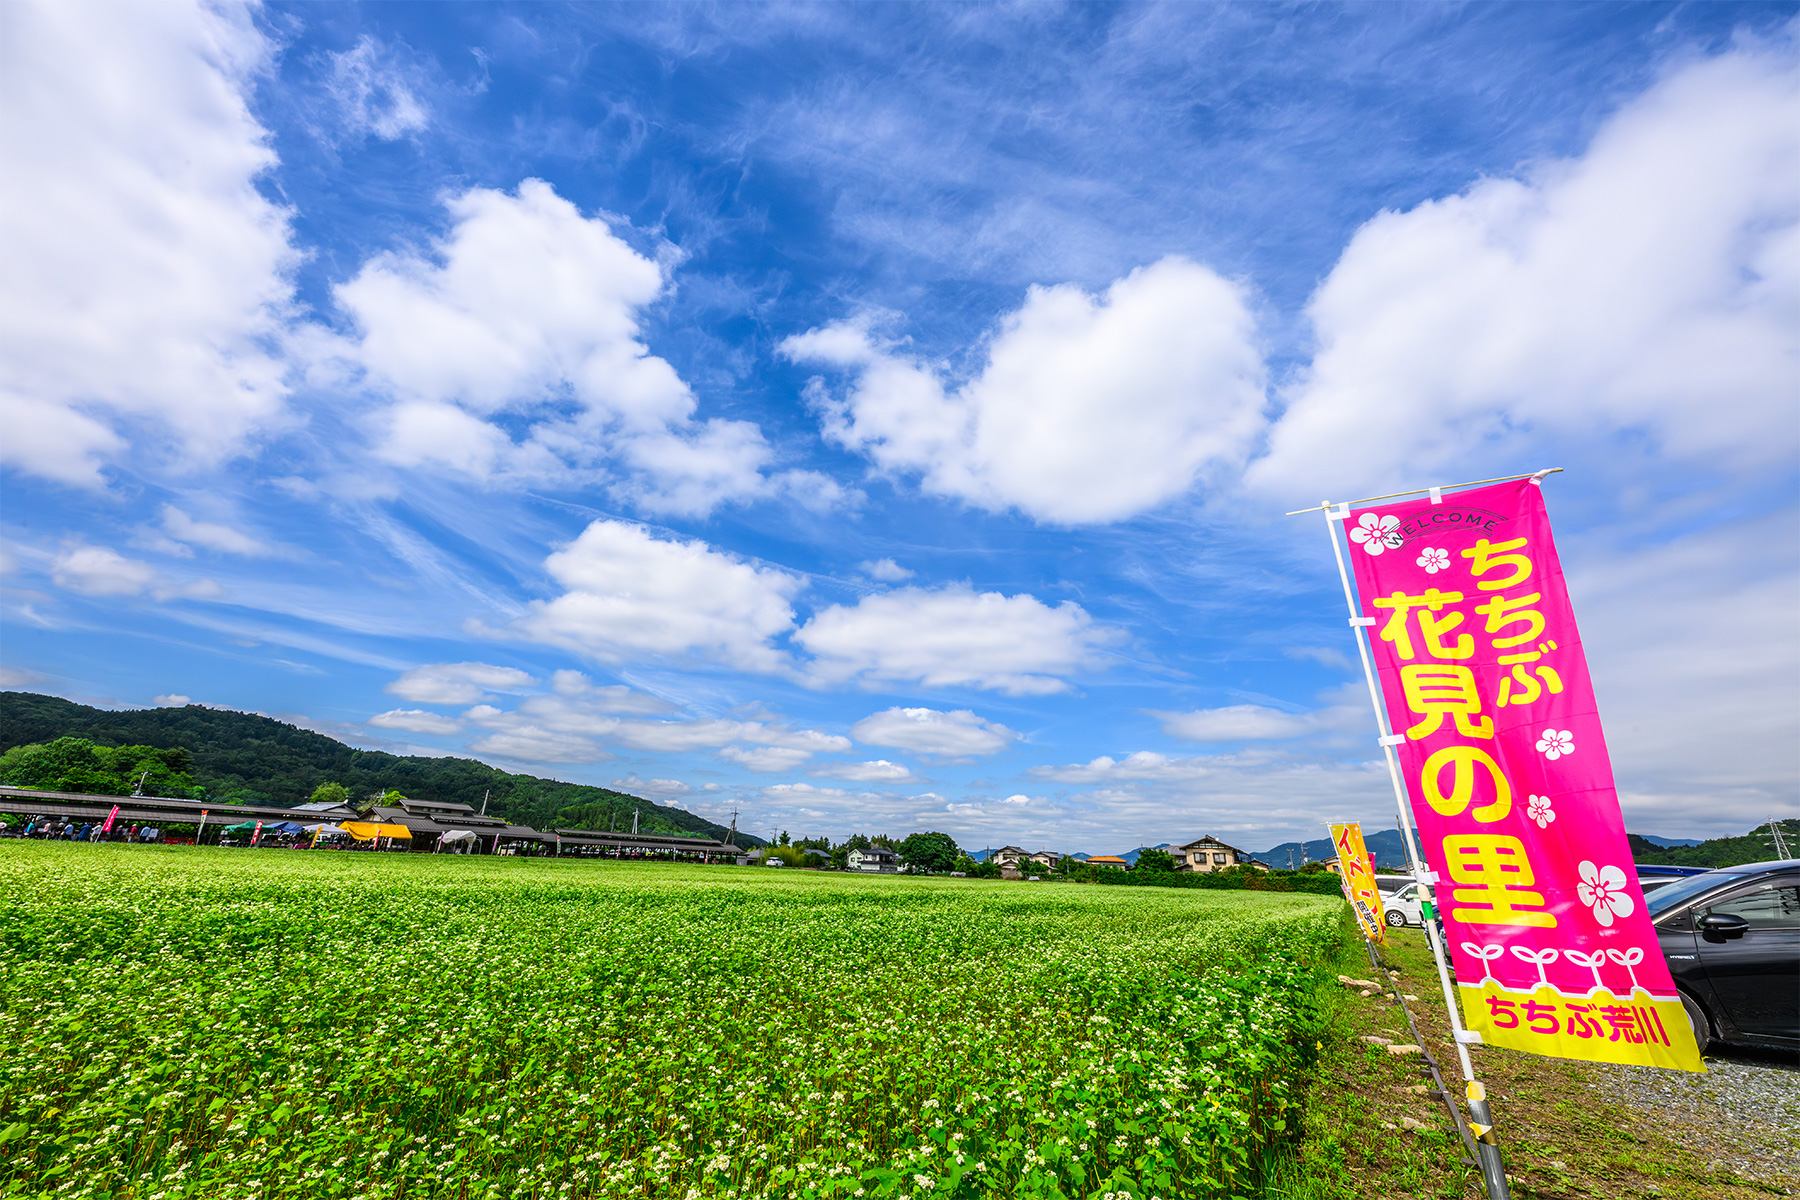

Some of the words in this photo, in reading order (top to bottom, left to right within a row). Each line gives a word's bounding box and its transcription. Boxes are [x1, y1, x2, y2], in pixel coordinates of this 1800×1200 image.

[1388, 512, 1499, 546] WELCOME
[1461, 537, 1563, 707] ちちぶ
[1373, 588, 1557, 928] 花見の里
[1485, 995, 1671, 1047] ちちぶ荒川
